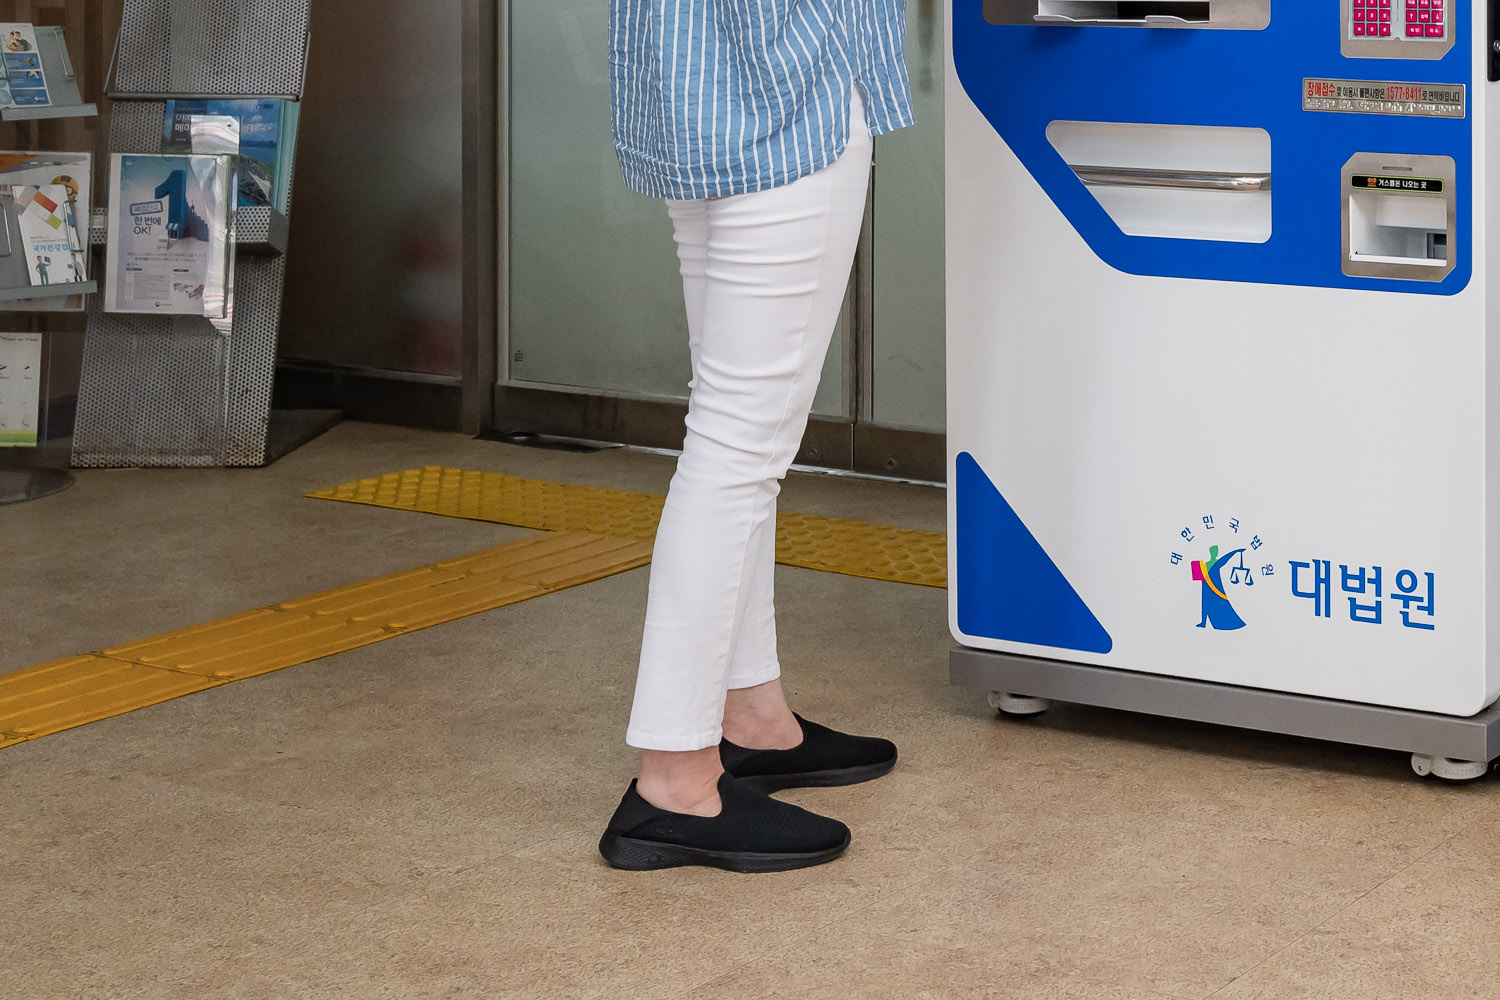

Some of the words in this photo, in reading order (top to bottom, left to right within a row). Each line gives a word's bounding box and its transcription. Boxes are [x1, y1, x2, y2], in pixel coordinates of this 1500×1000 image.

[1307, 81, 1336, 98] 장애접수
[1343, 85, 1359, 98] 이용시
[134, 226, 151, 235] OK!
[1288, 558, 1435, 631] 대법원
